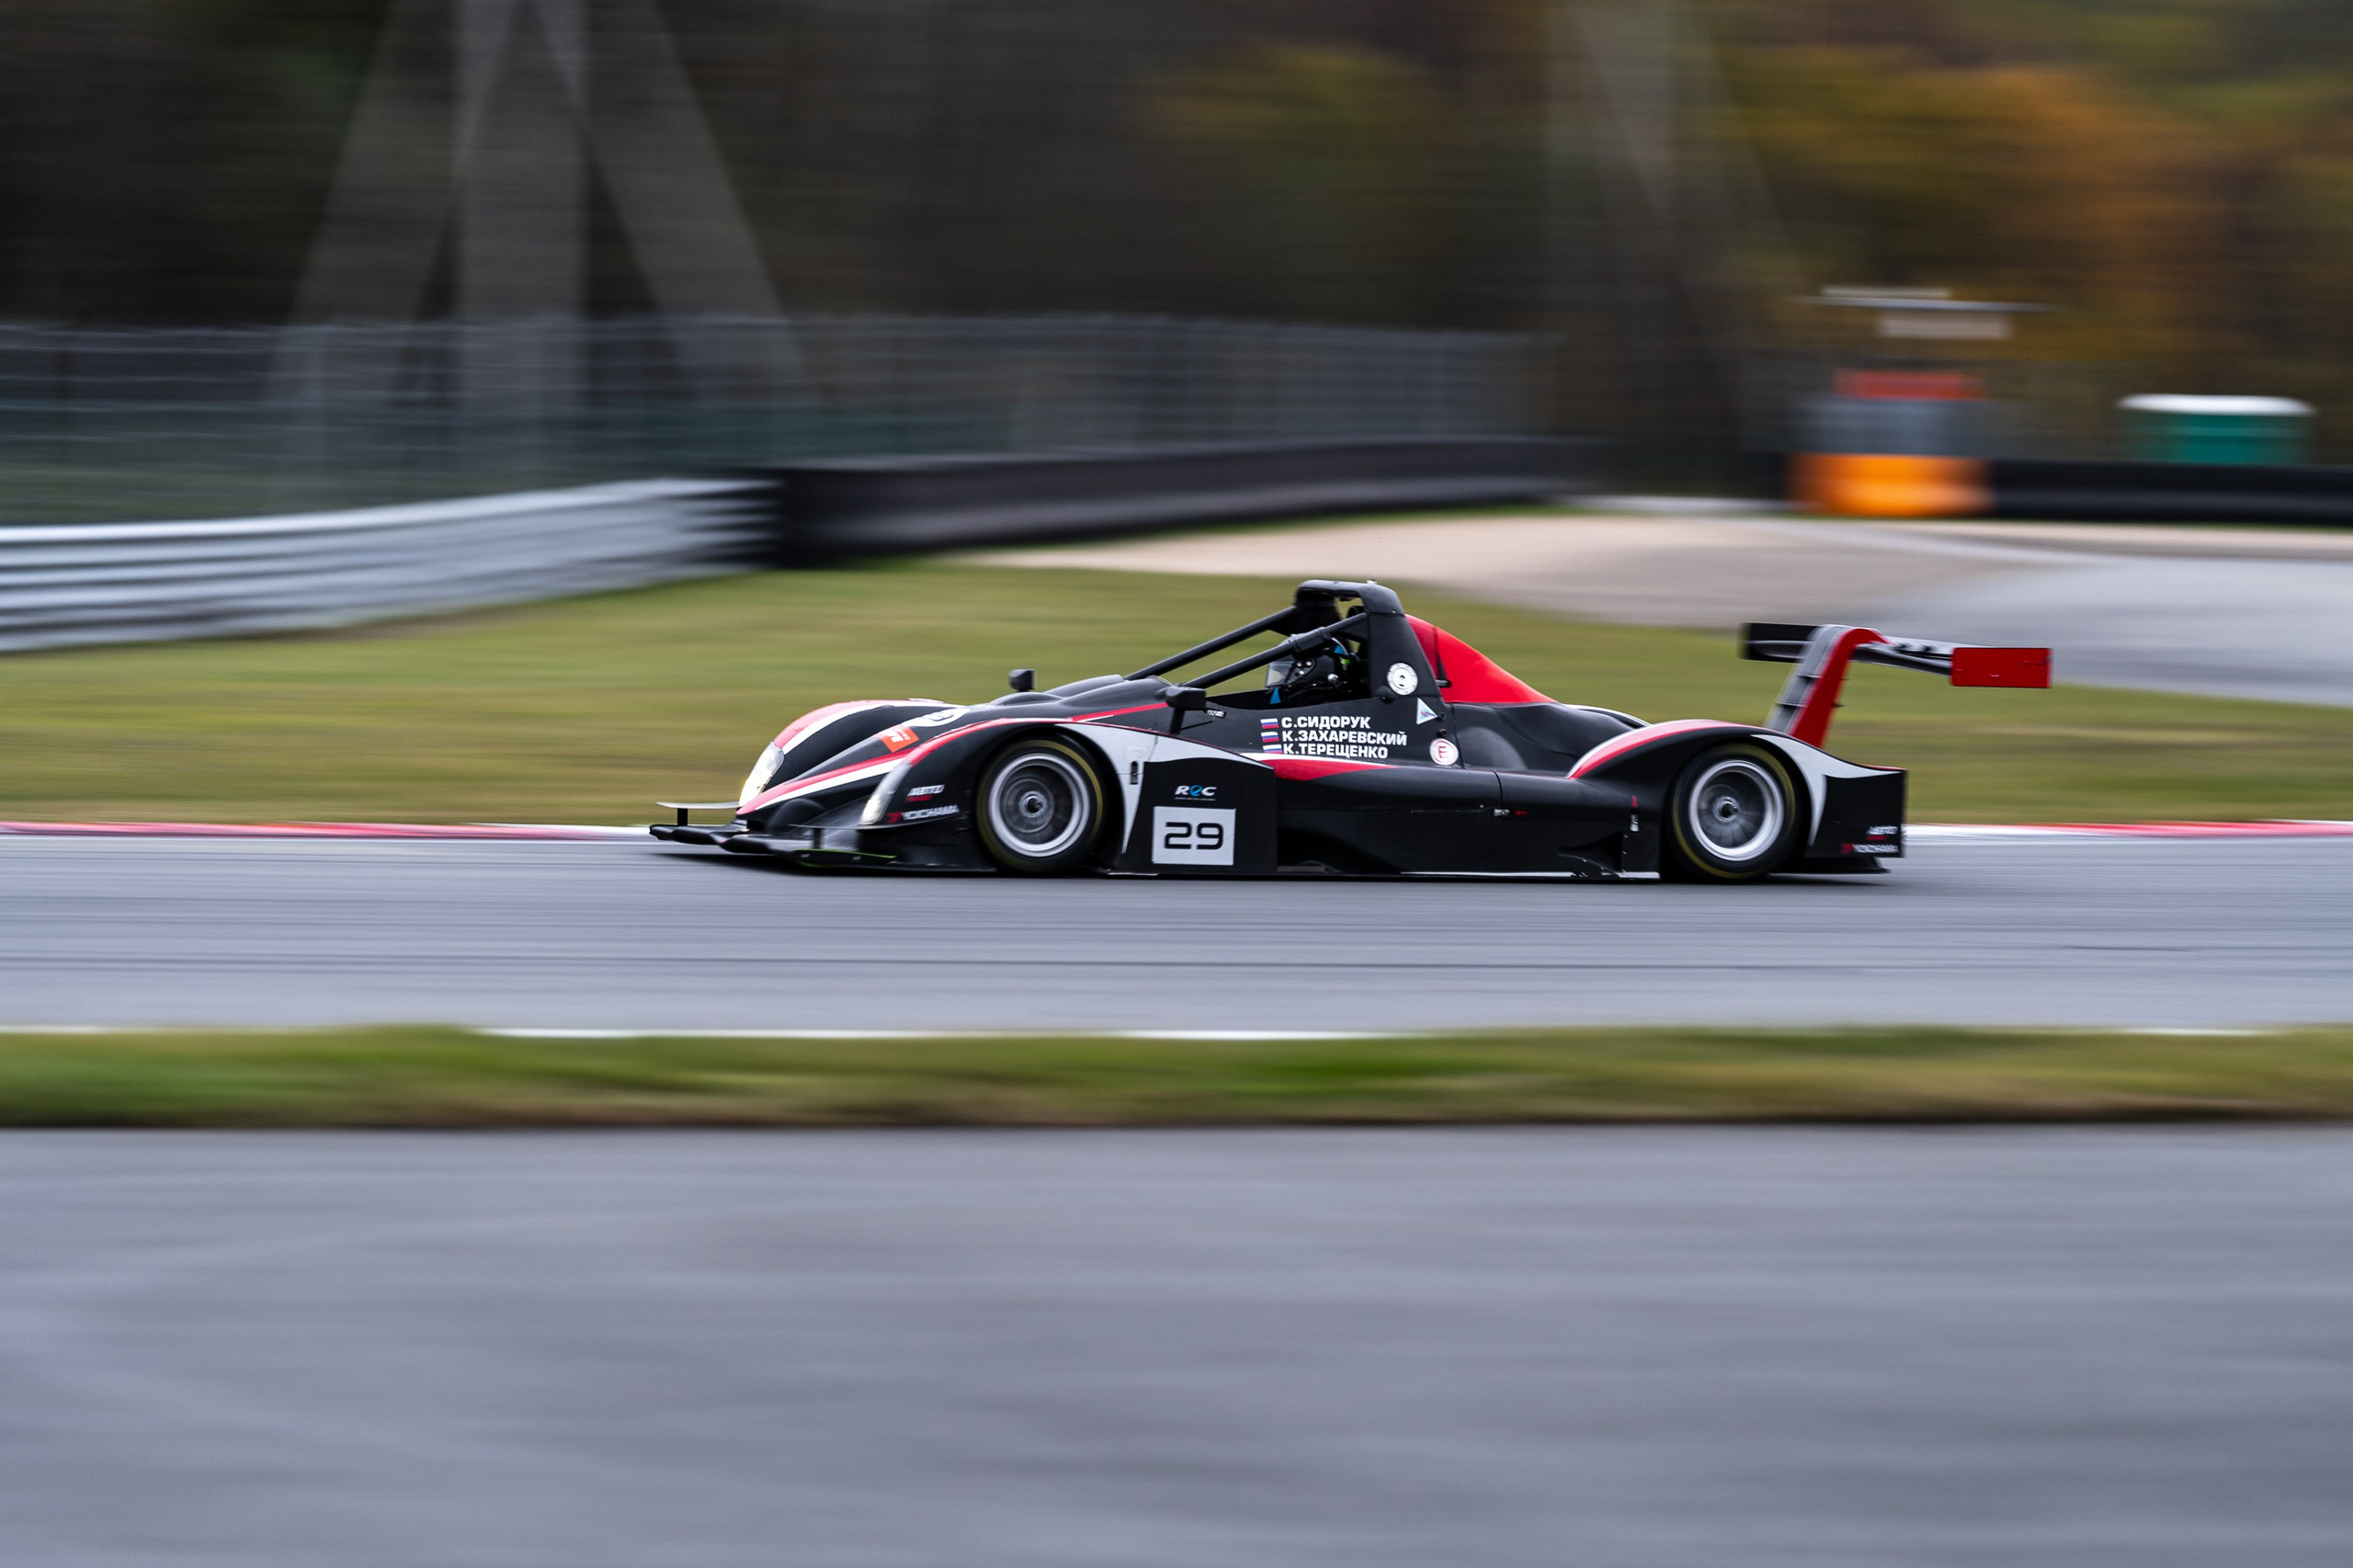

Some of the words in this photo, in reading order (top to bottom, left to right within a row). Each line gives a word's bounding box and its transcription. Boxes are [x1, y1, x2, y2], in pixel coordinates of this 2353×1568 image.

[1281, 716, 1370, 730] С.СИДОРУК
[1282, 730, 1407, 746] К.ЗАХАРЕВСКИЙ
[1282, 743, 1389, 759] К.ТЕРЕЩЕНКО
[1164, 821, 1224, 850] 29
